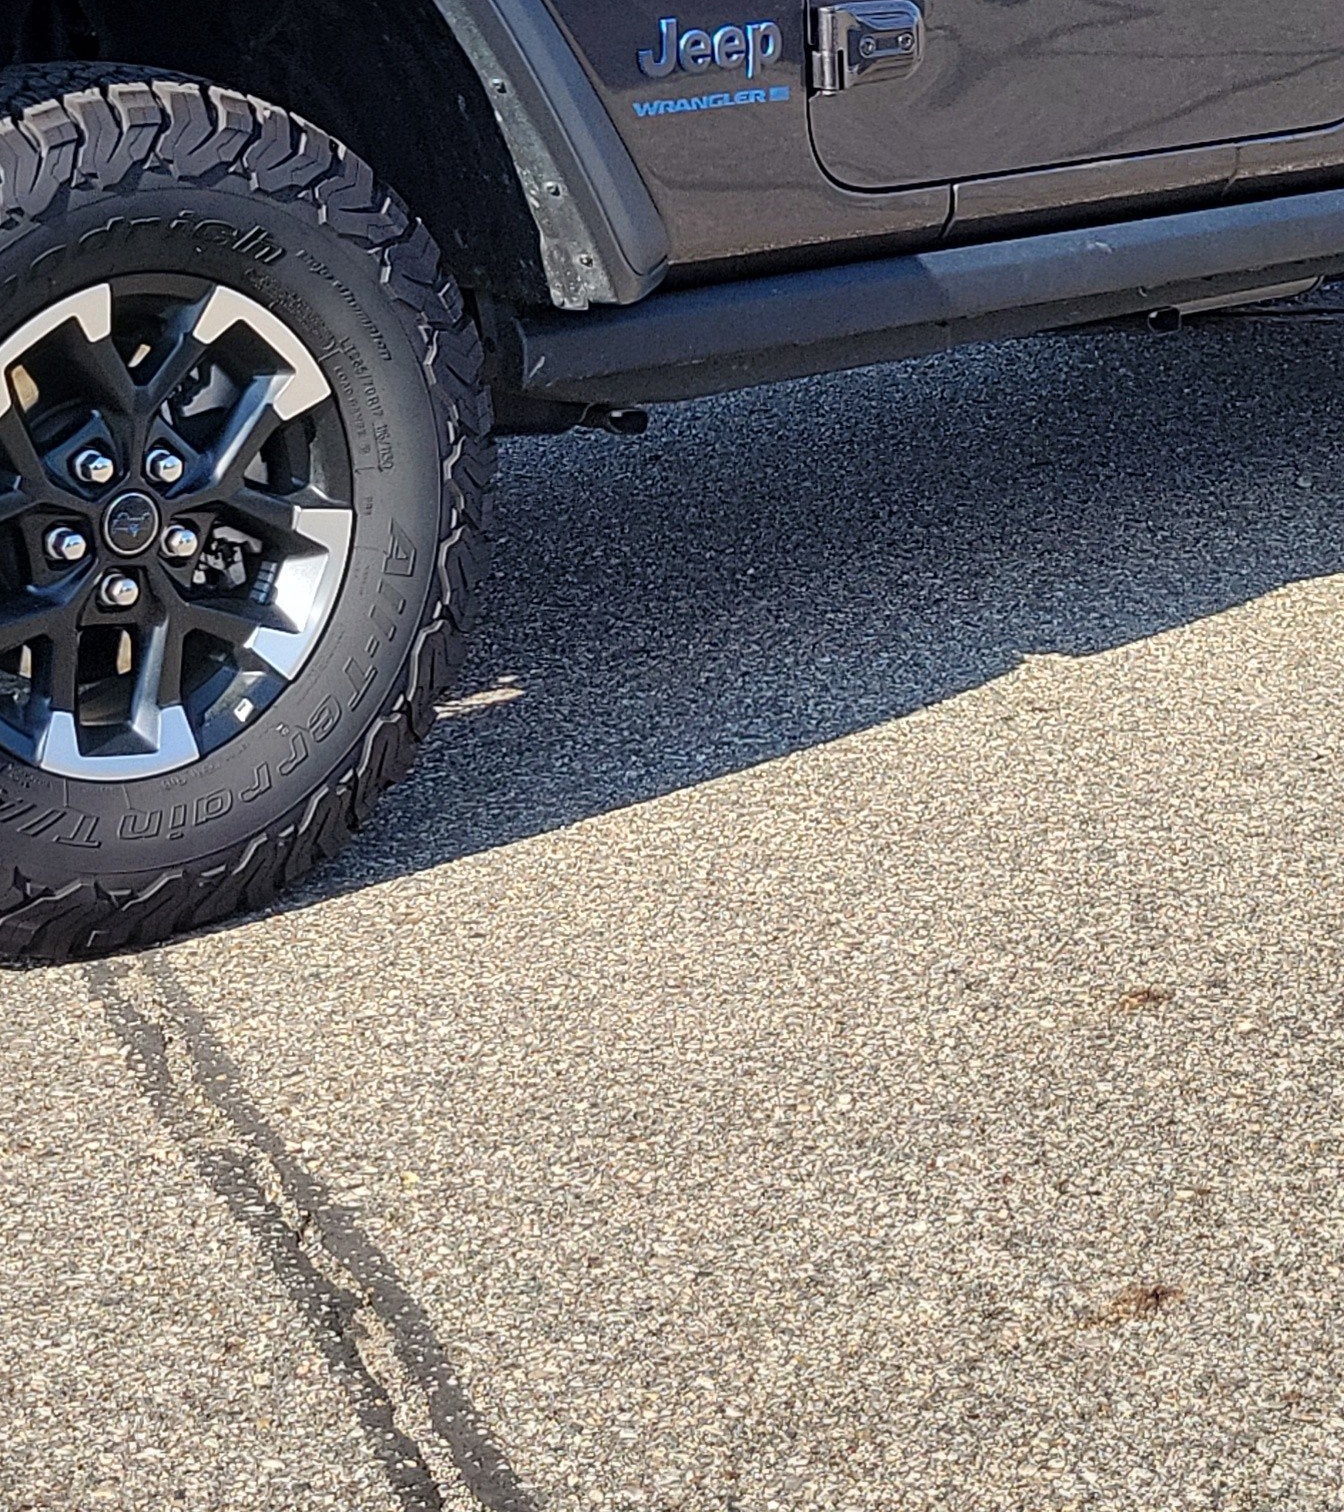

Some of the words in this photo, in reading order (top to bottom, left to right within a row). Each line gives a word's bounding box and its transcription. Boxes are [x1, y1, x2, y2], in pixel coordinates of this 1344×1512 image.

[636, 16, 783, 80] Jeep
[632, 90, 766, 118] WRANGLER
[117, 517, 417, 841] All-Terrain
